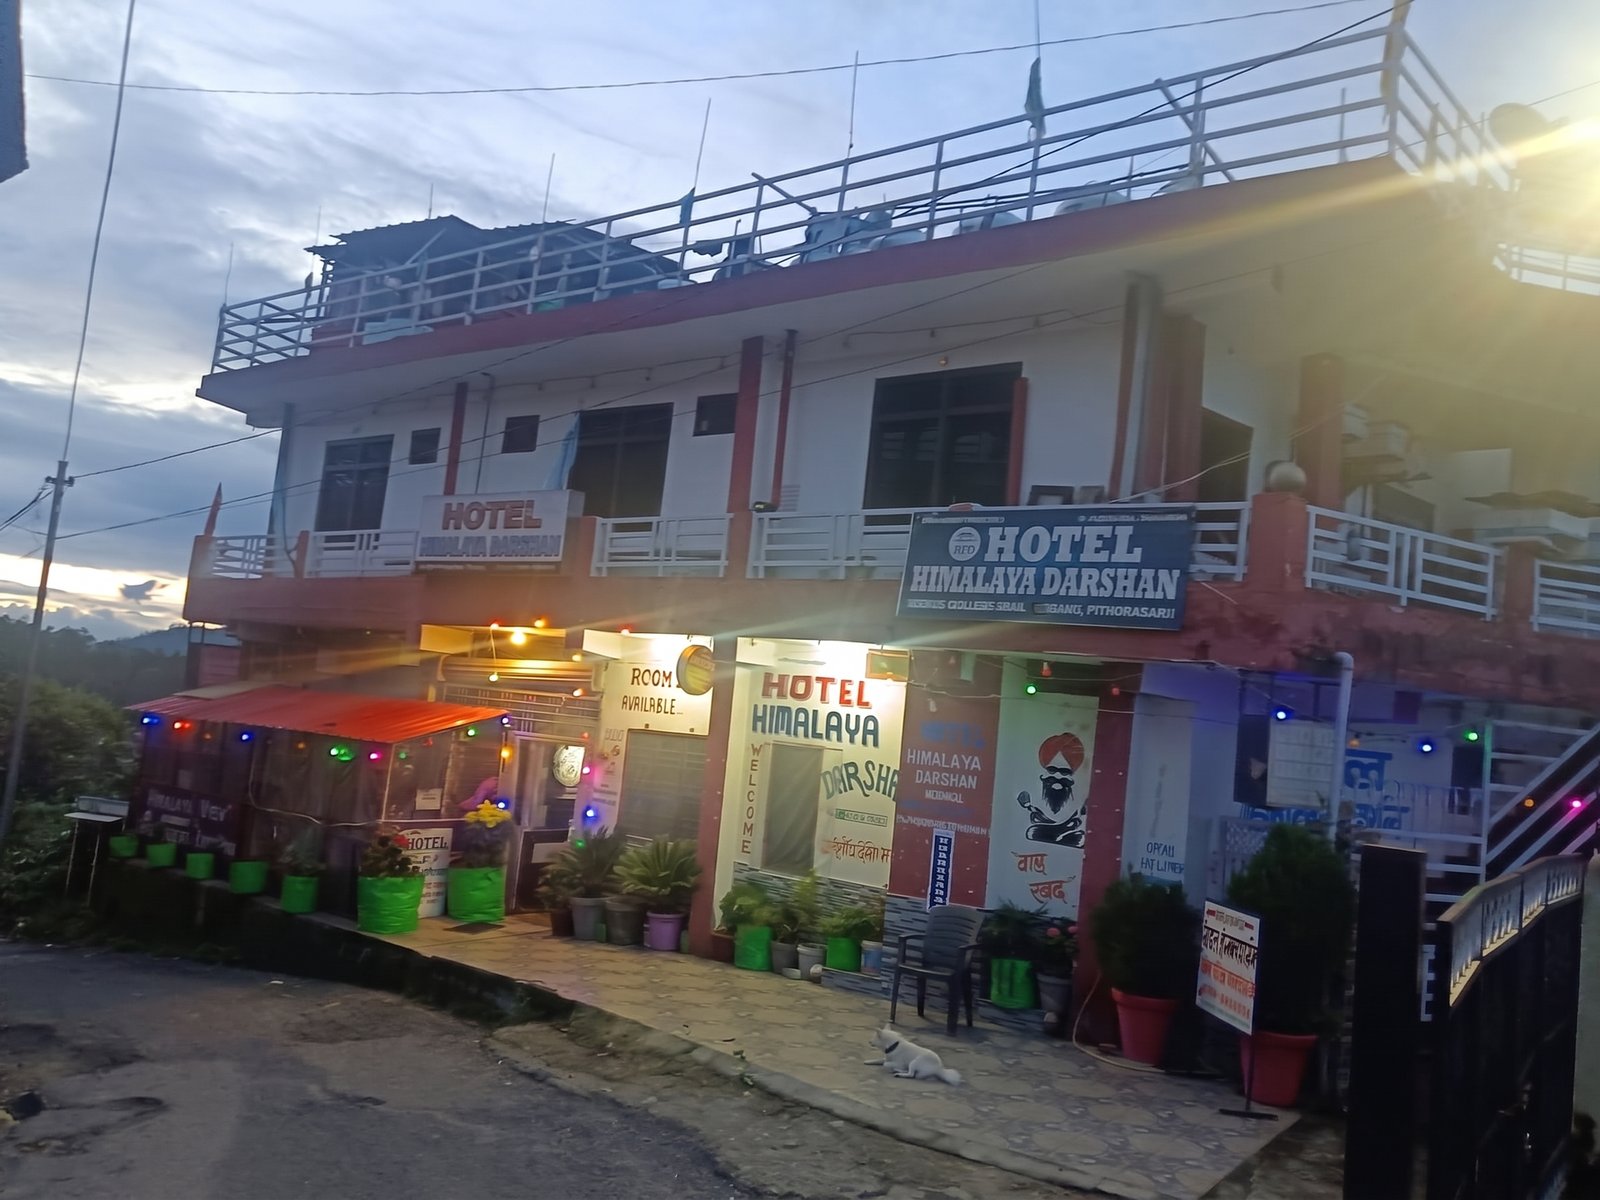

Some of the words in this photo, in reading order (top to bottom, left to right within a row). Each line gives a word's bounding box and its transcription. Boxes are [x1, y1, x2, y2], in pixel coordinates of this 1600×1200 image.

[442, 499, 542, 530] HOTEL
[983, 525, 1142, 563] HOTEL
[910, 565, 1036, 595] HIMALAYA
[1041, 567, 1181, 600] DARSHAN
[630, 667, 673, 688] ROOM
[761, 672, 872, 709] HOTEL
[752, 704, 880, 748] HIMALAYA
[907, 748, 982, 772] HIMALAYA
[915, 769, 978, 790] DARSHAN
[741, 744, 763, 855] WELCOME
